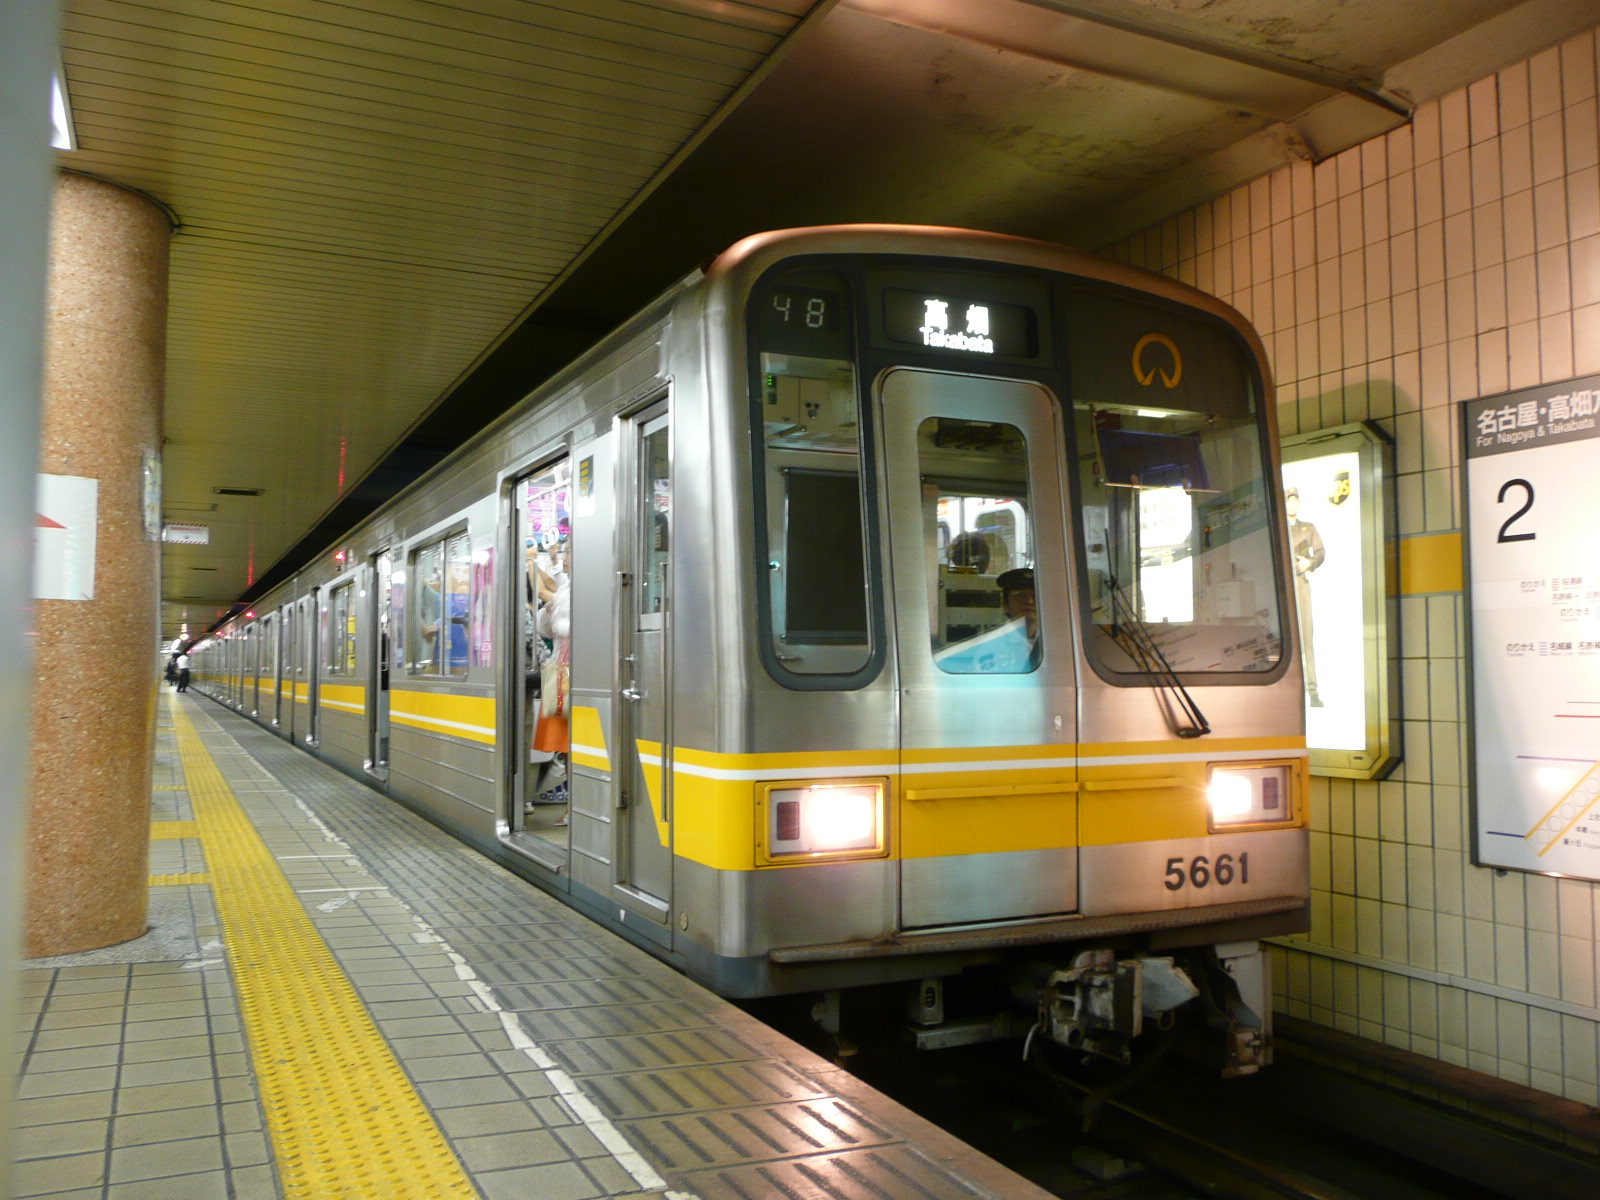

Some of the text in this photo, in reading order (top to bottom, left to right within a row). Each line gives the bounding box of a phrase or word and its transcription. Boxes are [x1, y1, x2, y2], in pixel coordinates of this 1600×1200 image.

[773, 295, 826, 328] 48
[919, 326, 994, 353] Takabata
[1476, 417, 1595, 447] For Nagoya & Takabata
[1497, 478, 1536, 544] 2
[1164, 851, 1249, 891] 5661
